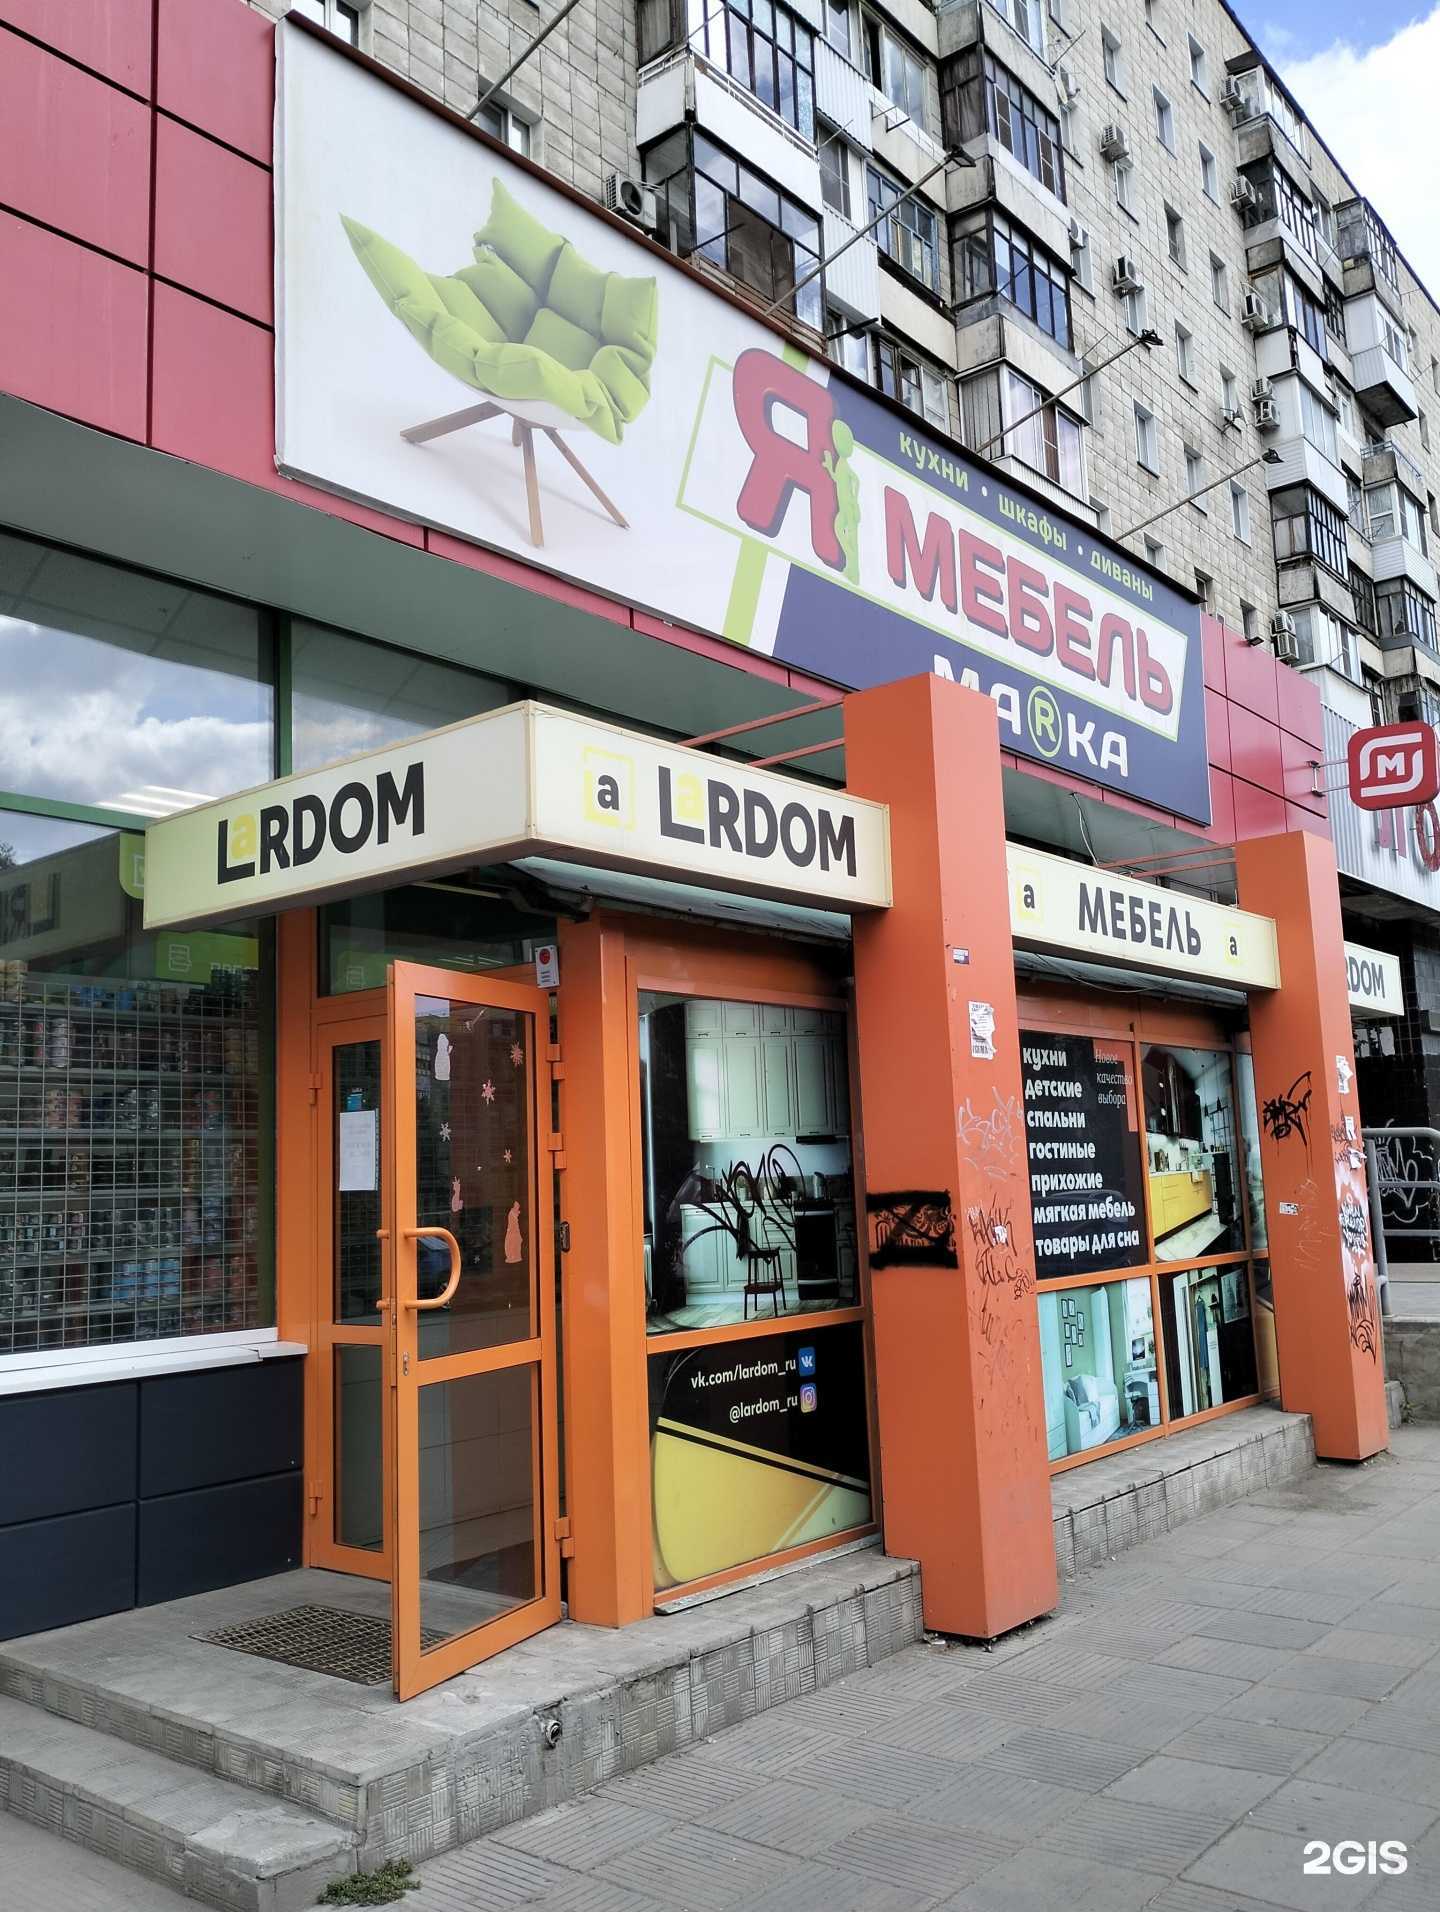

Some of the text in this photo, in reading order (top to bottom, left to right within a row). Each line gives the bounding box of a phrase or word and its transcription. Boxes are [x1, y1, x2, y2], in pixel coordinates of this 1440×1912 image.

[900, 432, 1153, 602] кухни шкафы диваны
[732, 347, 1175, 717] Я МЕБЕЛЬ
[1078, 882, 1202, 956] МЕБЕЛЬ
[1022, 1047, 1067, 1071] кухни
[1095, 1049, 1118, 1065] Новое
[1024, 1078, 1083, 1100] детские
[1096, 1072, 1132, 1086] качество
[1097, 1089, 1127, 1109] выбора
[1026, 1110, 1086, 1128] спальни
[1029, 1142, 1096, 1159] гостиные
[1031, 1172, 1104, 1198] прихожие
[1033, 1195, 1136, 1224] мягкая мебель
[1036, 1230, 1140, 1259] товары для сна
[690, 1359, 796, 1389] vk.com/lardom_ru
[729, 1395, 798, 1423] @lardom_ru
